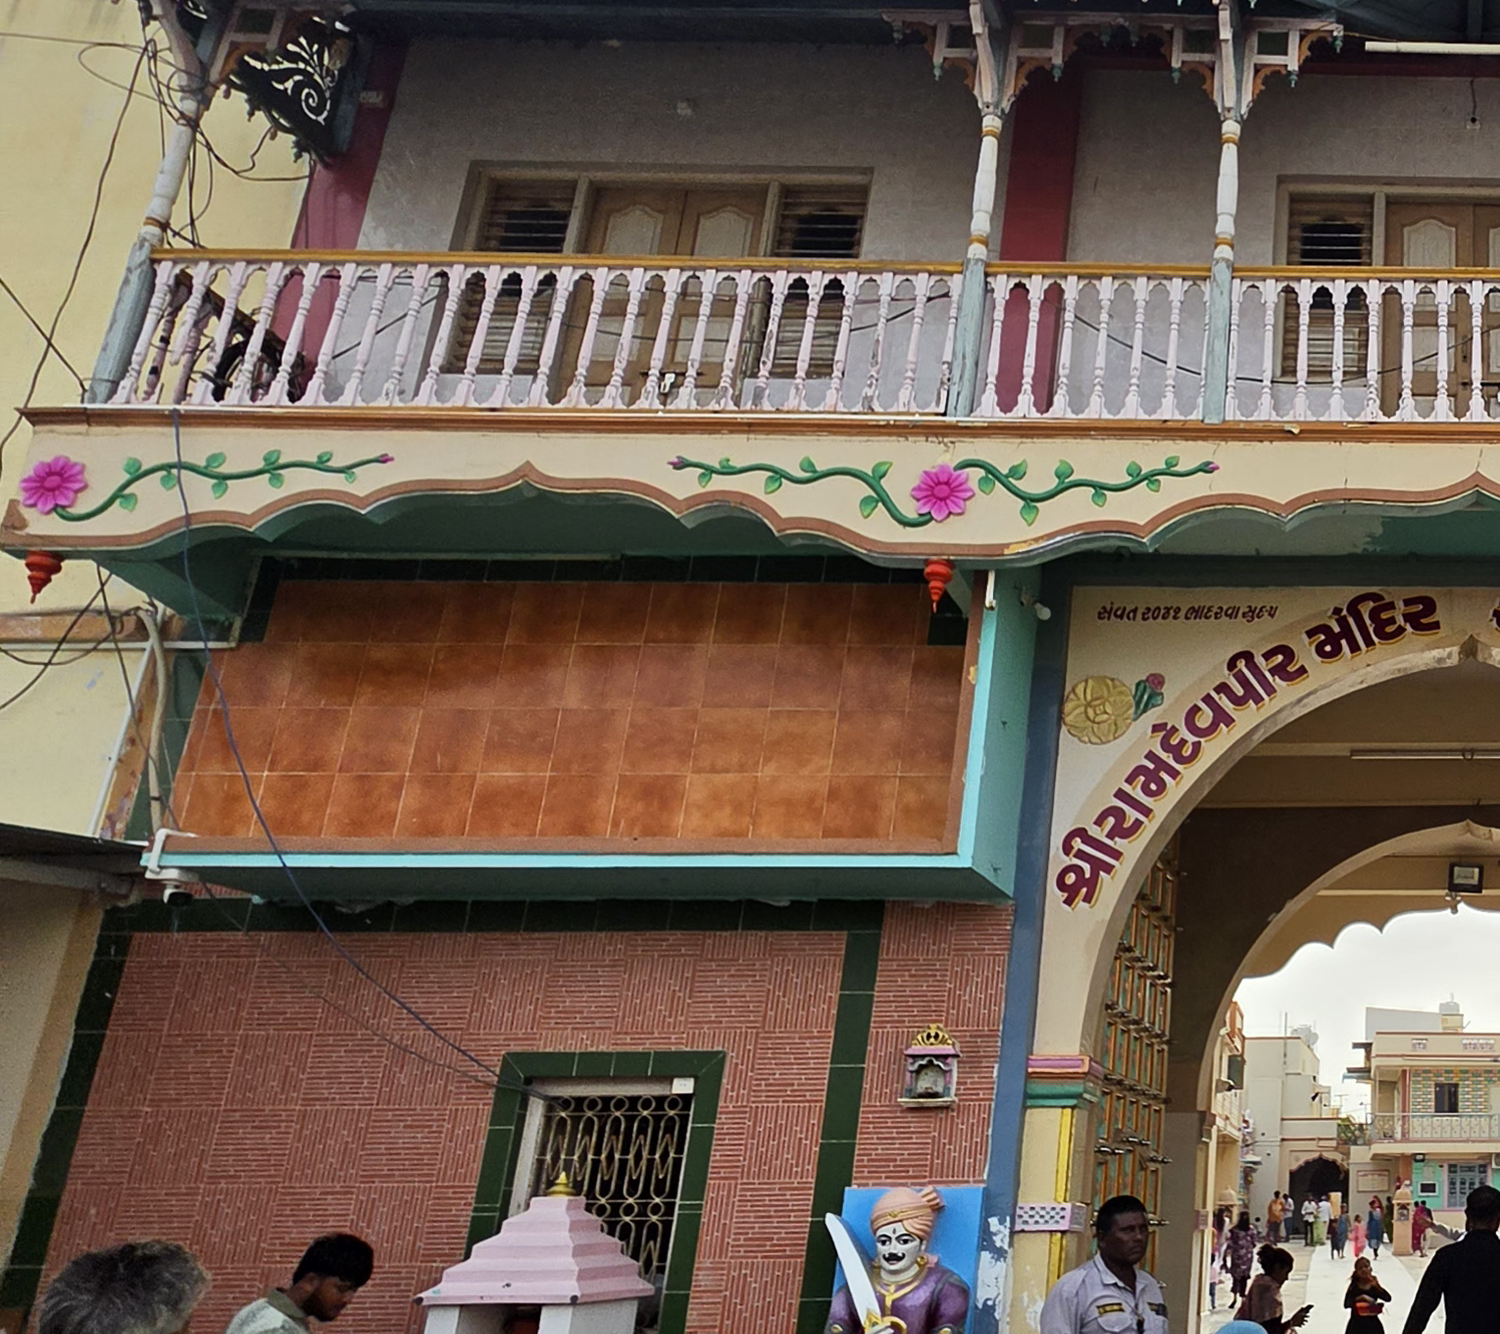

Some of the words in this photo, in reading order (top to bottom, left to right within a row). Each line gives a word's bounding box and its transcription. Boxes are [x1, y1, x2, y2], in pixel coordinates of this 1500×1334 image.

[1097, 602, 1138, 621] સંવત
[1184, 605, 1240, 621] ભાદરવા
[1304, 591, 1442, 664] મંદિર
